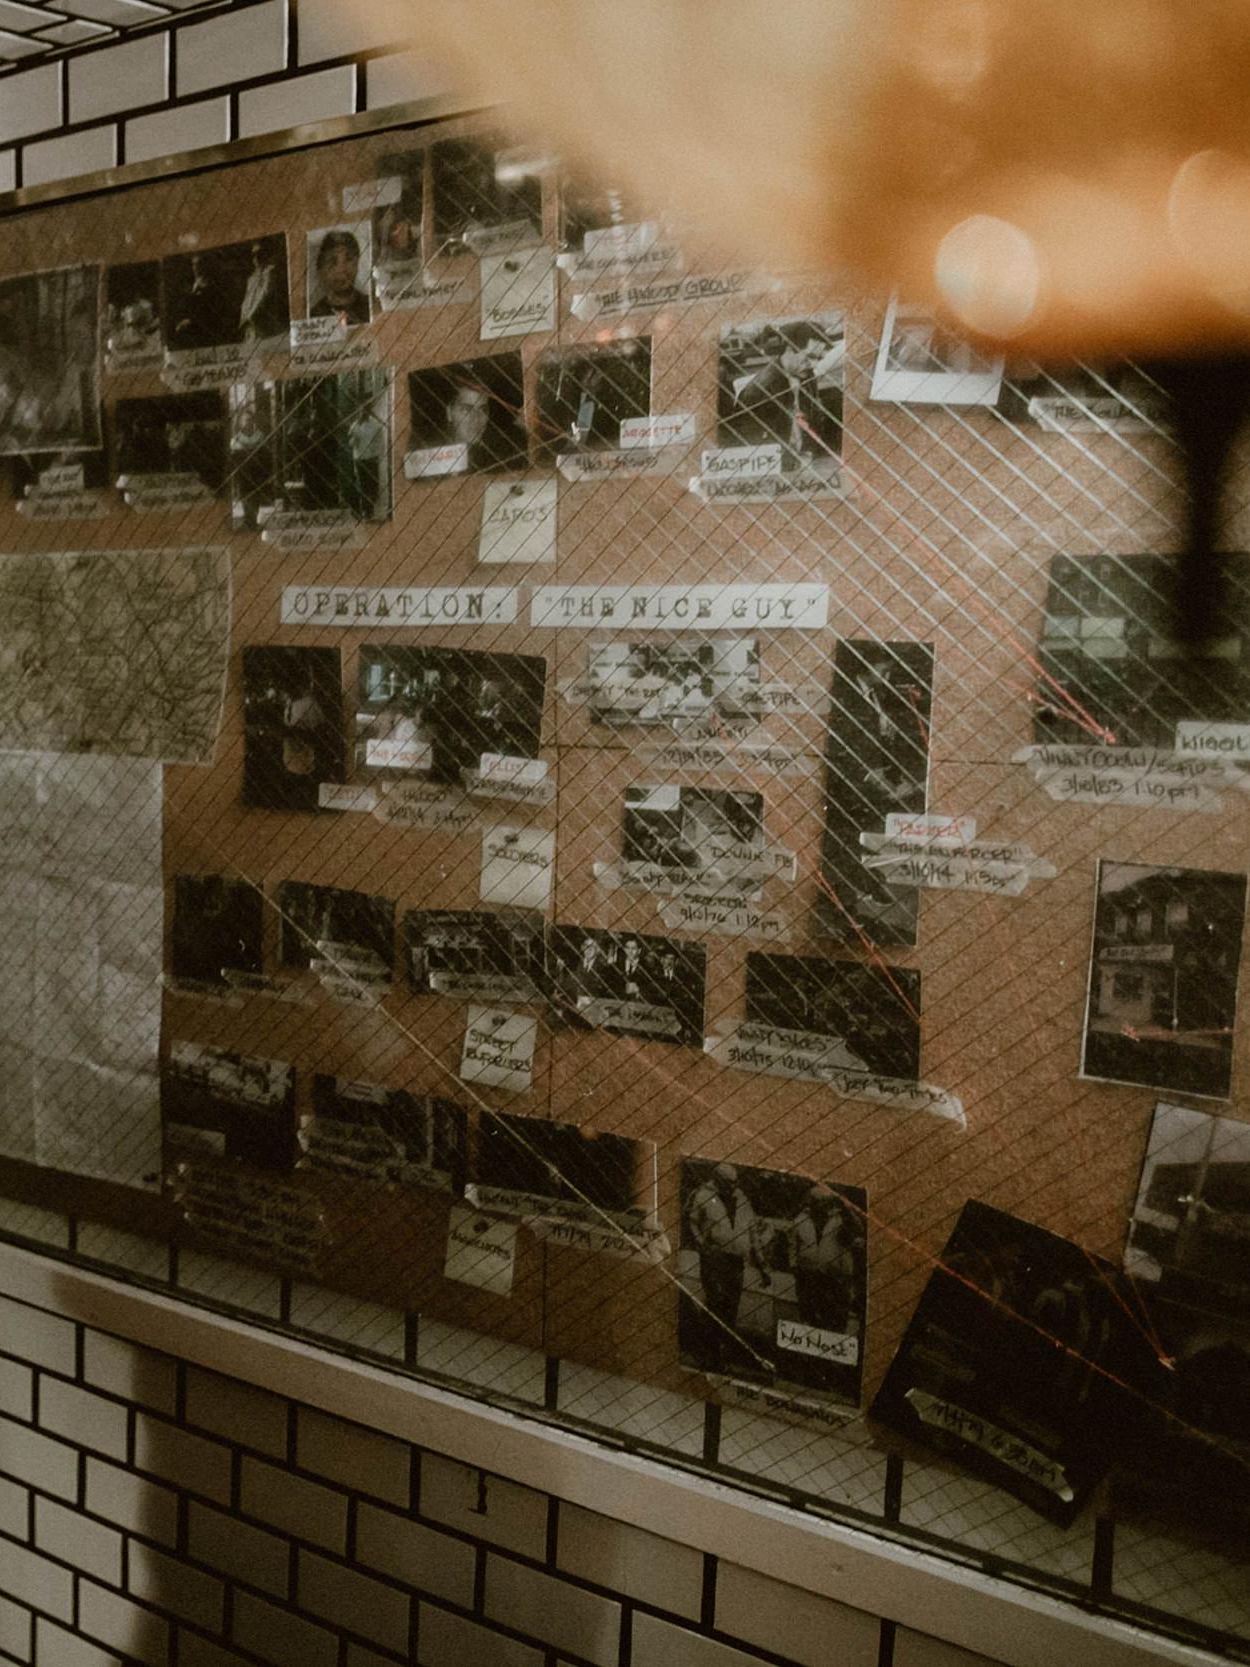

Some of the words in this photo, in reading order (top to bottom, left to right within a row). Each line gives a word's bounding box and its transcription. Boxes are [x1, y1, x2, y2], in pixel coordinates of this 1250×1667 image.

[686, 274, 741, 294] GROUP
[293, 592, 503, 619] OPERATION:
[631, 595, 713, 619] NICE
